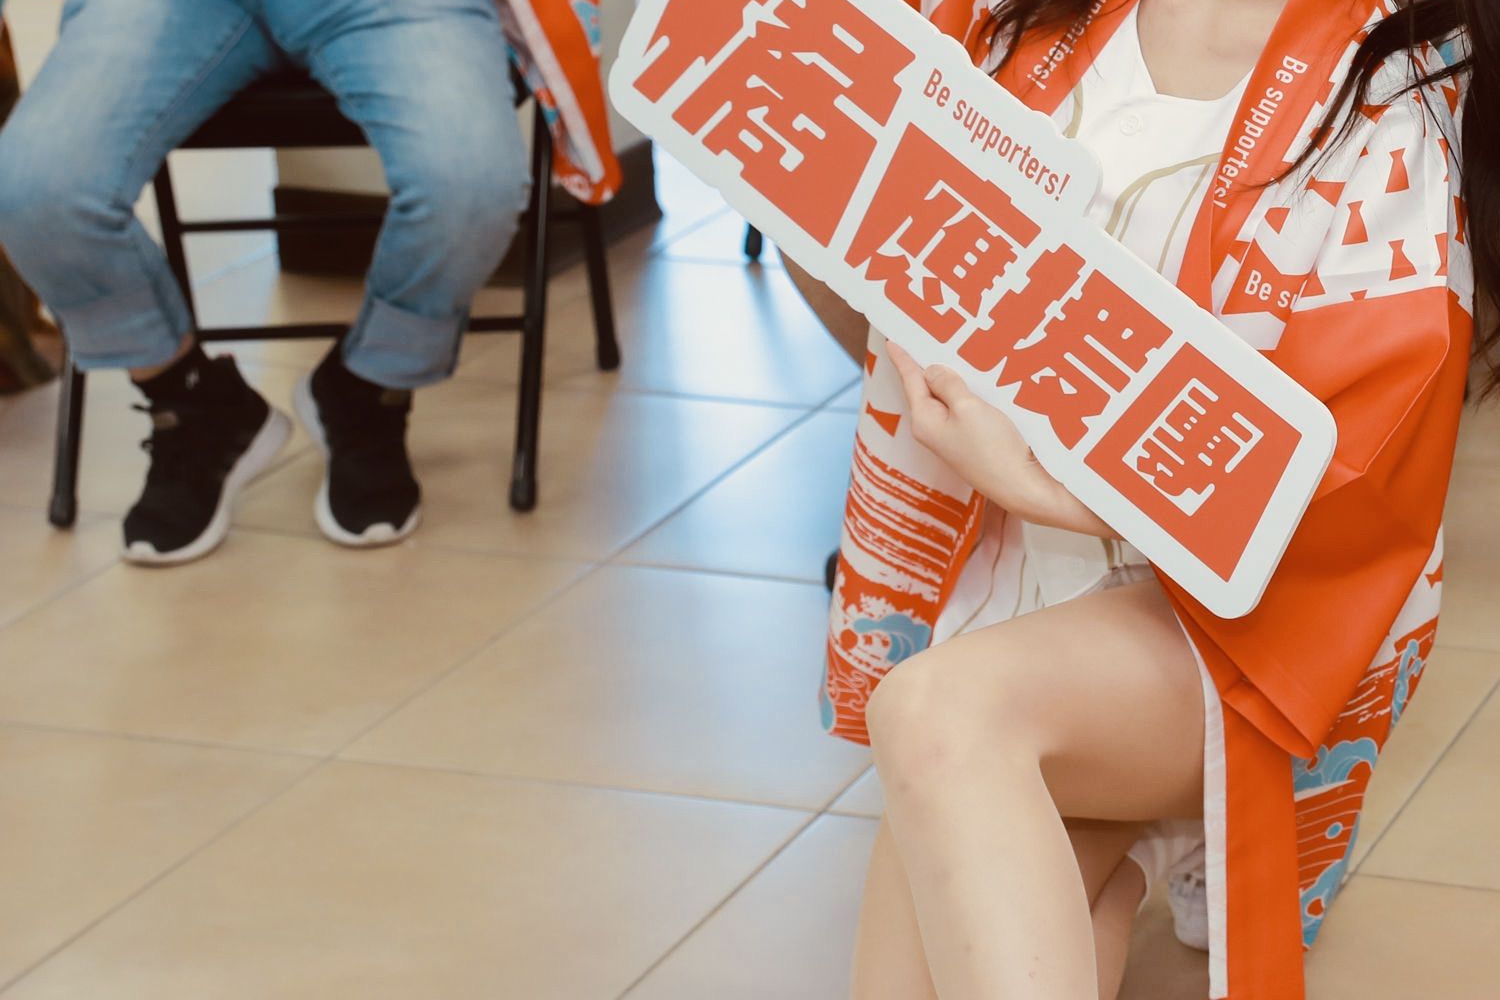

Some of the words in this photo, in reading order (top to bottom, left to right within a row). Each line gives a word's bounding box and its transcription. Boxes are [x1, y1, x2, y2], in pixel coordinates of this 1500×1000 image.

[1275, 55, 1308, 85] Be
[923, 67, 951, 108] Be
[952, 98, 1073, 201] supporters!
[1212, 87, 1284, 210] supporters!
[1244, 269, 1273, 302] Be
